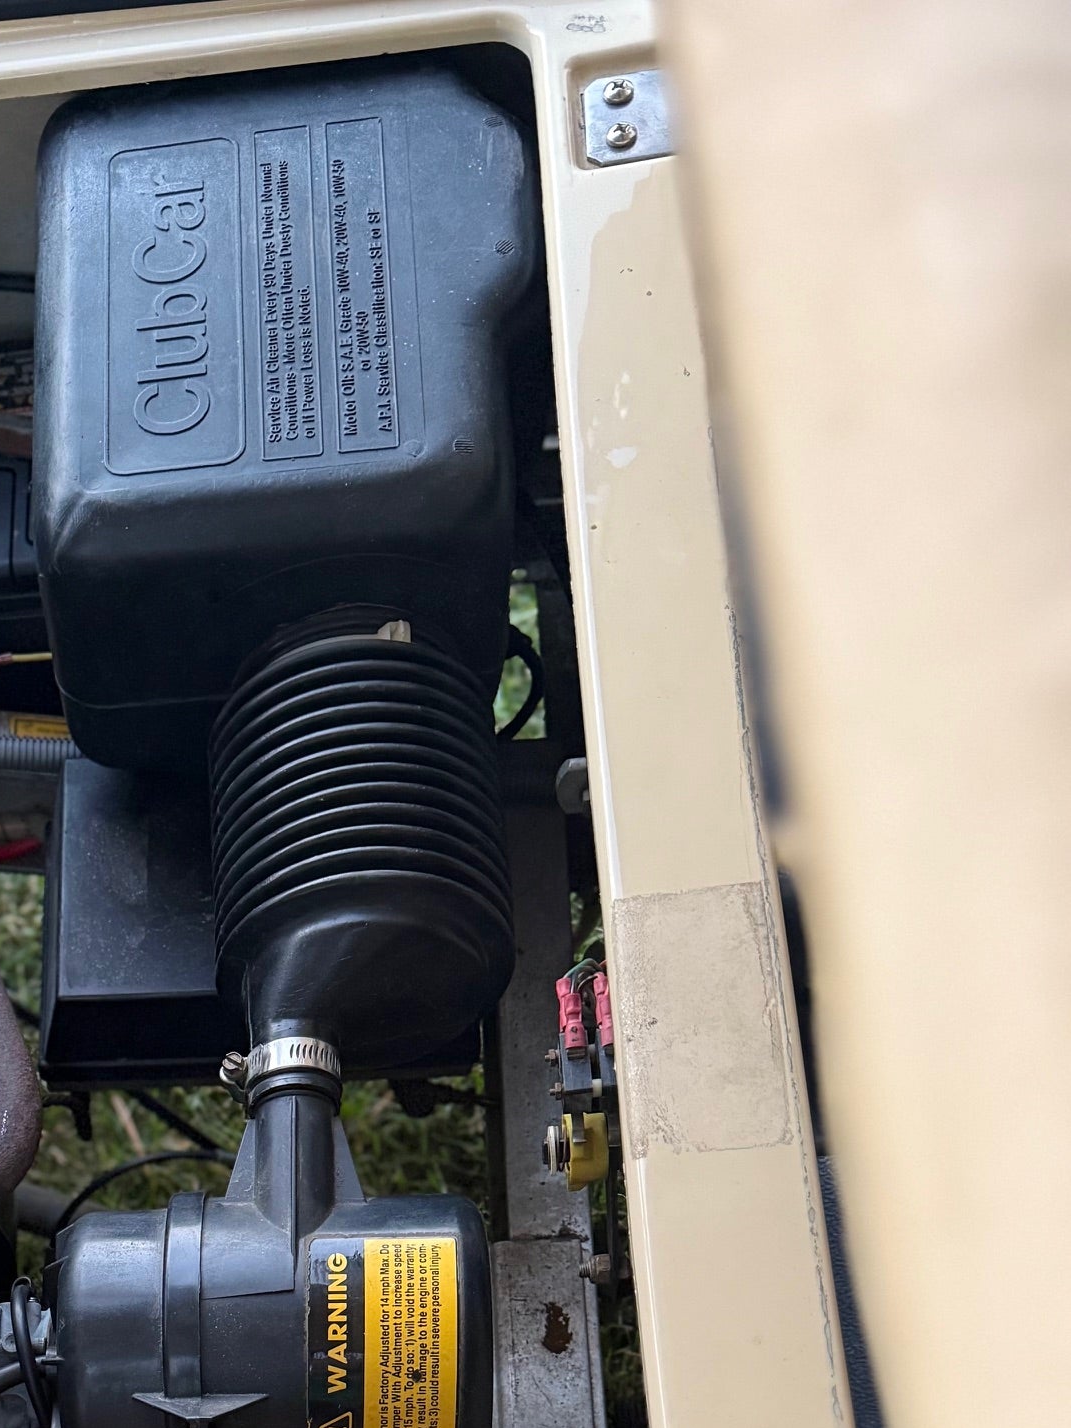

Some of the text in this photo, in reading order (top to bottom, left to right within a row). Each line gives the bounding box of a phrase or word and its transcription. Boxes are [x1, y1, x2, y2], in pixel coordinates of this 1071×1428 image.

[260, 162, 273, 202] Normal
[277, 160, 290, 221] Conditions
[261, 206, 274, 239] Under
[367, 207, 381, 224] SF
[279, 224, 293, 257] Dusty
[371, 228, 381, 240] or
[263, 242, 277, 270] Days
[369, 242, 382, 259] SE
[262, 274, 276, 288] 90
[280, 260, 293, 294] Under
[264, 291, 279, 323] Every
[281, 297, 295, 330] Often
[298, 285, 310, 325] Noted.
[339, 296, 352, 333] Grade
[299, 328, 311, 338] is
[266, 328, 279, 374] Cleaner
[283, 333, 295, 364] More
[301, 340, 313, 370] Loss
[339, 336, 353, 372] S.A.E.
[361, 359, 371, 371] or
[376, 350, 389, 396] Service
[301, 374, 314, 412] Power
[285, 372, 298, 440] Conditions
[343, 400, 357, 436] Motor
[267, 397, 281, 443] Service
[305, 427, 315, 439] or
[380, 1245, 389, 1254] Do
[393, 1244, 404, 1267] speed
[419, 1244, 427, 1263] com-
[430, 1244, 441, 1267] injury.
[380, 1256, 389, 1274] Max.
[406, 1244, 416, 1280] warranty;
[420, 1266, 427, 1274] or
[380, 1277, 392, 1295] mph
[392, 1270, 402, 1306] increase
[405, 1283, 414, 1296] the
[418, 1277, 429, 1308] engine
[430, 1268, 441, 1306] personal
[380, 1298, 389, 1307] 14
[393, 1310, 402, 1319] to
[405, 1299, 414, 1318] void
[327, 1253, 348, 1393] WARNING
[380, 1310, 389, 1322] for
[418, 1312, 427, 1327] the
[405, 1321, 414, 1336] will
[418, 1330, 427, 1340] to
[379, 1325, 392, 1367] Adjusted
[392, 1323, 404, 1378] Adjustment
[430, 1341, 439, 1349] in
[404, 1367, 414, 1378] do
[430, 1352, 439, 1378] result
[379, 1370, 391, 1404] Factory
[392, 1381, 401, 1403] With
[404, 1381, 414, 1391] To
[417, 1386, 426, 1394] in
[430, 1380, 439, 1406] could
[379, 1406, 388, 1414] is
[404, 1394, 416, 1417] mph.
[417, 1398, 426, 1424] result
[429, 1408, 440, 1416] 3)
